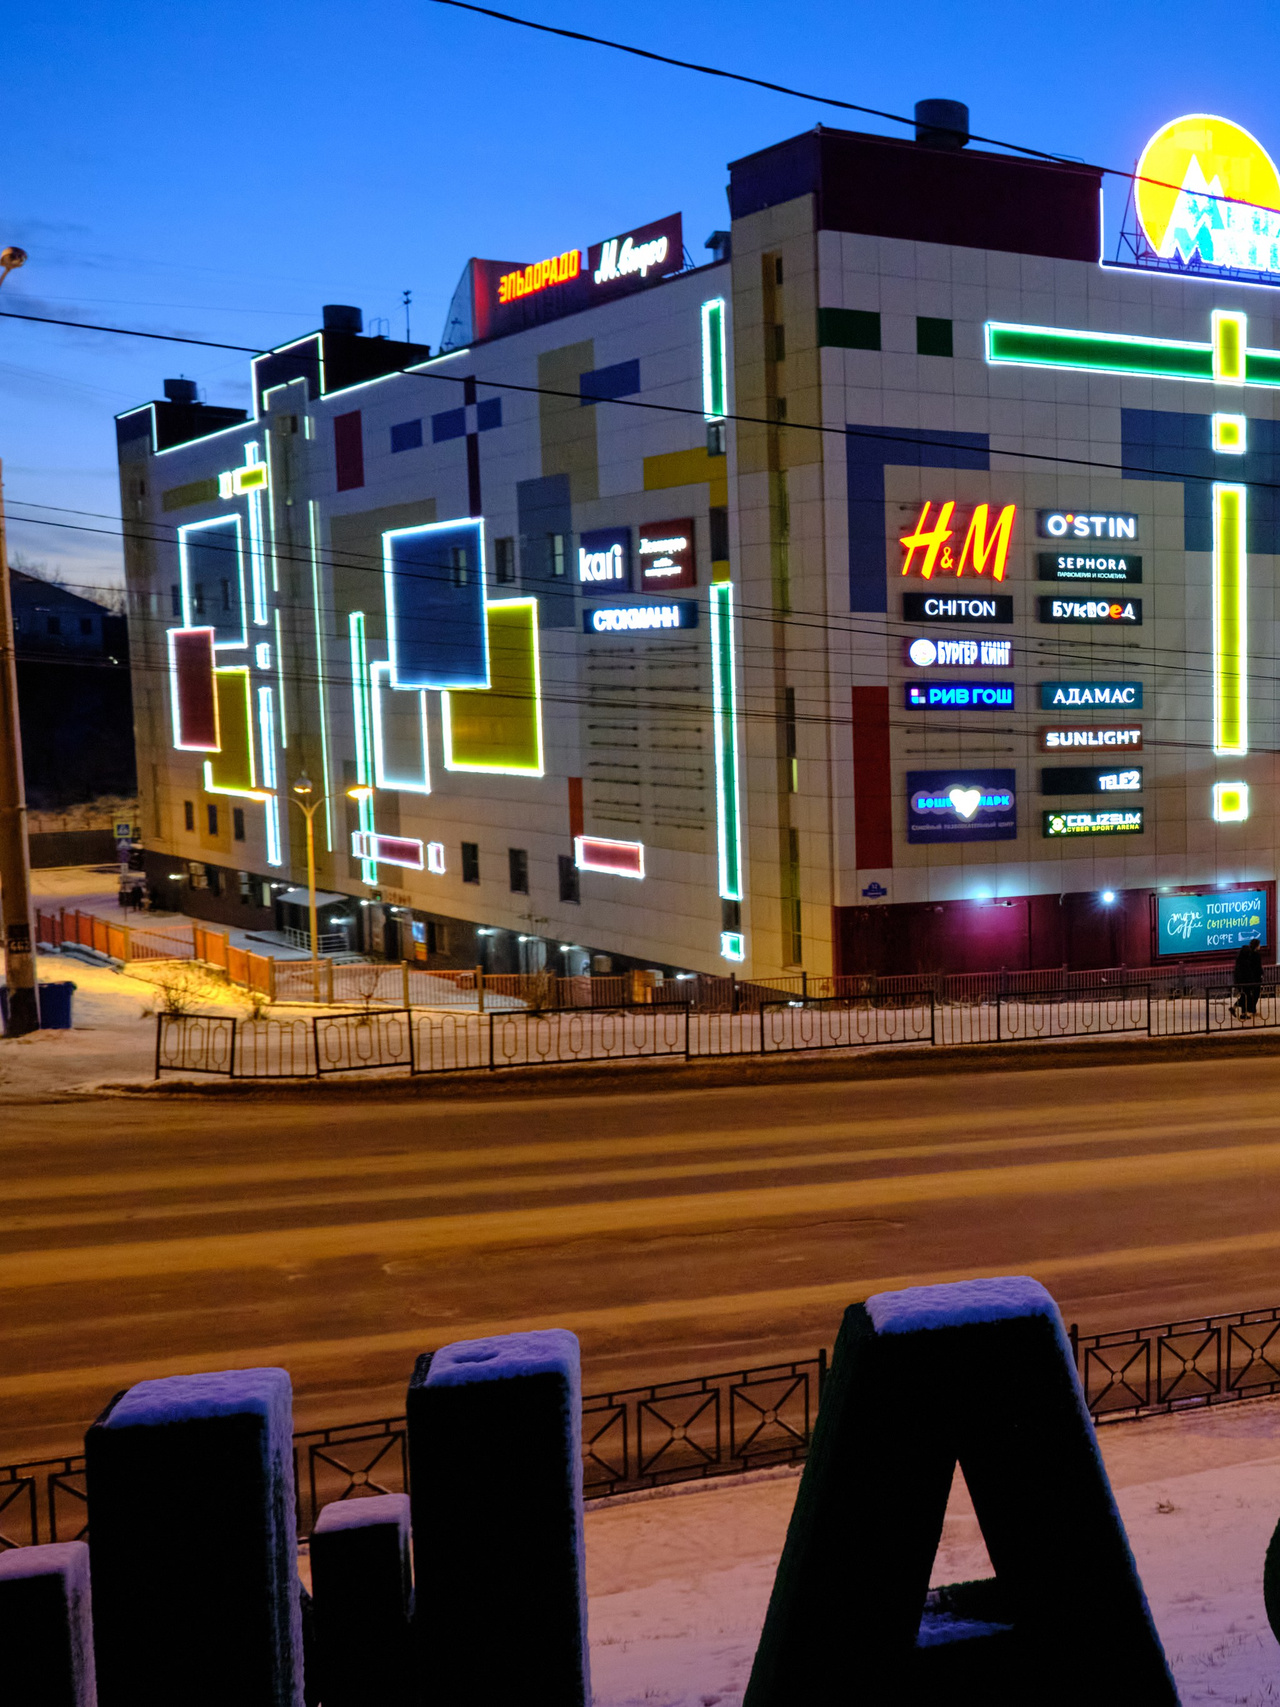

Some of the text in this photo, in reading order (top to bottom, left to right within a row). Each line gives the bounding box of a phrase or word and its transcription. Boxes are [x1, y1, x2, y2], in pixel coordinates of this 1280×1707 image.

[498, 249, 582, 304] ЭЛЬДОРАДО
[899, 500, 1016, 583] H&M
[578, 543, 623, 582] kari
[1058, 557, 1127, 570] SEPHORA
[924, 599, 996, 617] CHITON
[937, 641, 1012, 665] БУРГЕР КИНГ
[929, 688, 1012, 704] РИВ ГОШ
[1053, 687, 1135, 706] АДАМАС
[1046, 730, 1141, 747] SUNLIGHT
[1098, 770, 1140, 791] TELE2
[1206, 897, 1261, 915] ПОПРОБУЙ
[1206, 914, 1249, 930] СЫРНЫЙ
[1206, 933, 1234, 947] КОФЕ
